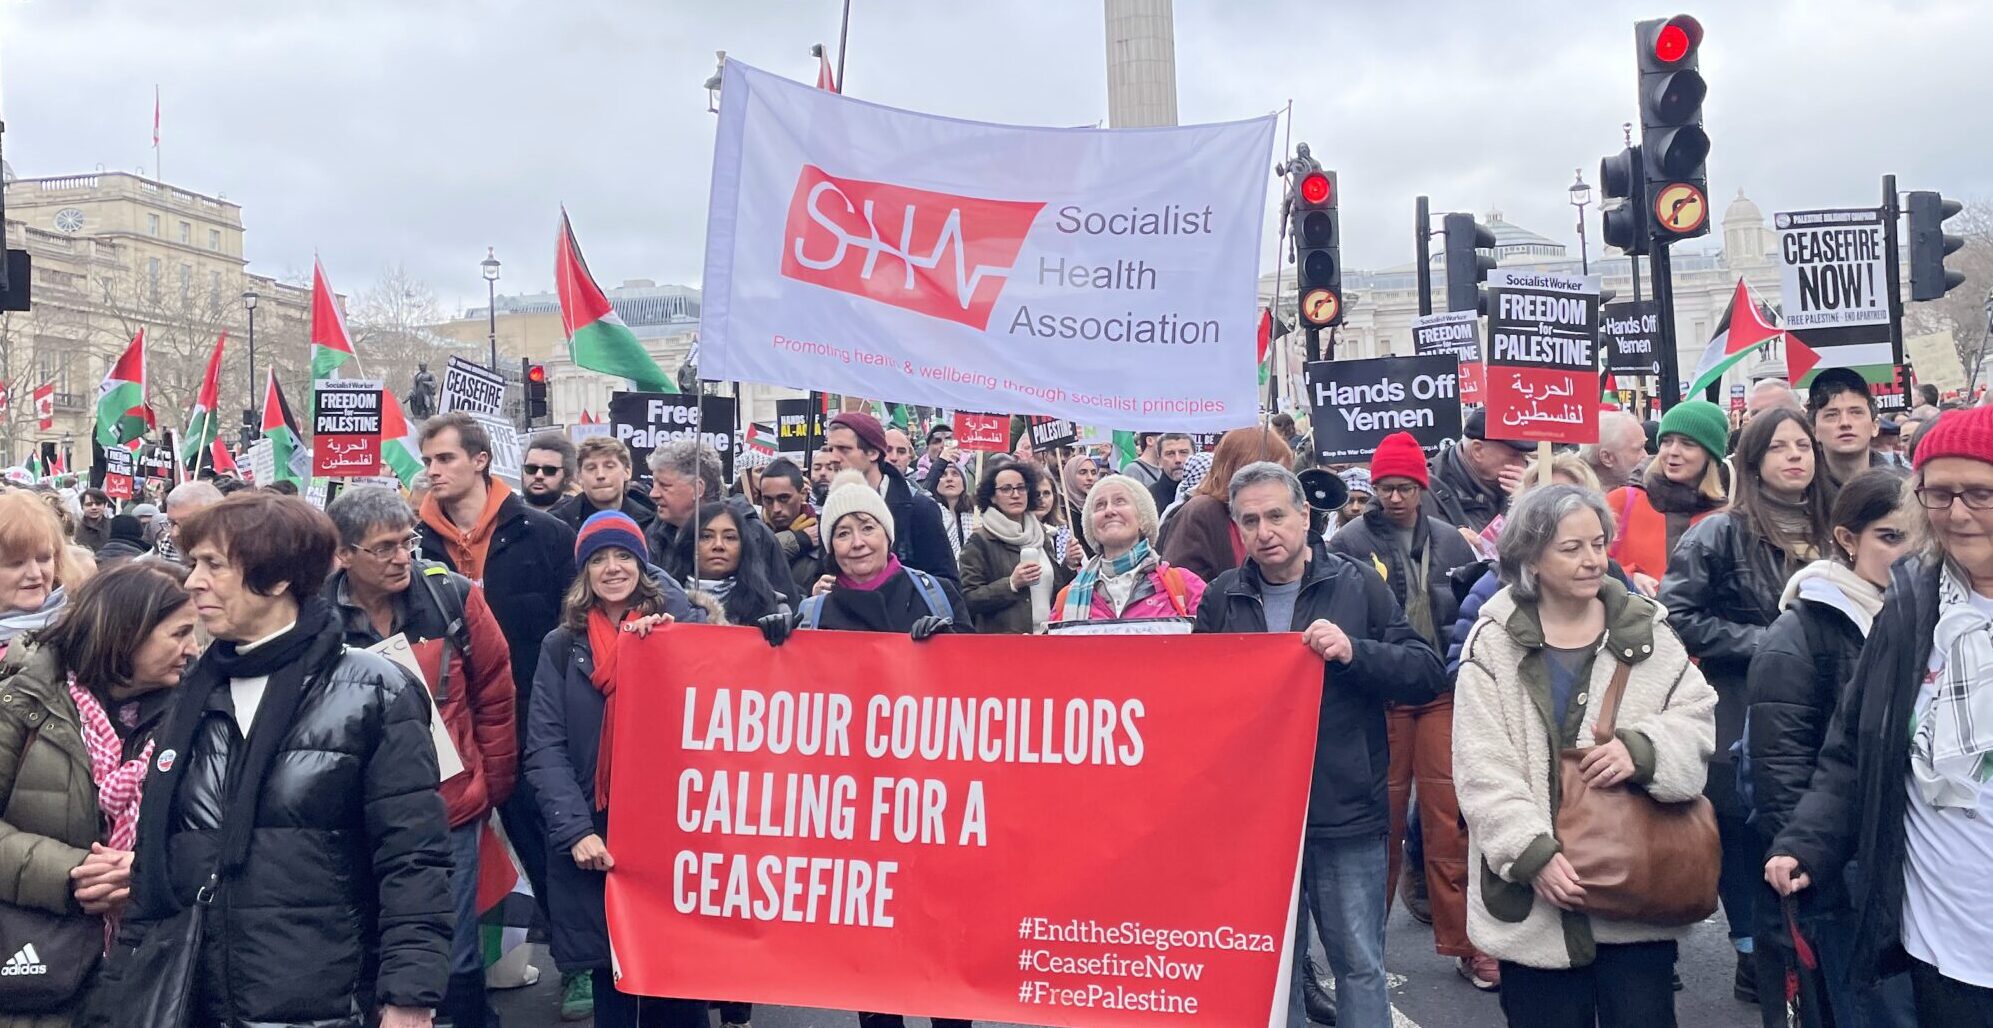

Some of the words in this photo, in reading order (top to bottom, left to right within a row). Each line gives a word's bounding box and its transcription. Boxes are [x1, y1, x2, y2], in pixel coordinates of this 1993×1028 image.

[1055, 204, 1213, 235] Socialist
[1783, 228, 1881, 265] CEASEFIRE
[1038, 256, 1158, 291] Health
[1798, 262, 1876, 311] NOW!
[1500, 293, 1587, 326] FREEDOM
[1787, 314, 1805, 325] FREE
[1806, 312, 1840, 325] PALESTINE
[1845, 311, 1856, 321] END
[1857, 309, 1887, 321] APARTHEID
[1009, 305, 1220, 345] Association
[1418, 323, 1473, 344] FREEDOM
[1538, 321, 1553, 335] for
[1606, 317, 1641, 335] Hands
[1641, 314, 1656, 333] Off
[1494, 333, 1592, 366] PALESTINE
[1615, 336, 1652, 354] Yemen
[773, 335, 850, 363] Promoting
[903, 360, 914, 375] &
[919, 364, 998, 390] wellbeing
[1003, 379, 1066, 402] through
[1071, 390, 1137, 411] socialist
[1143, 397, 1225, 415] principles
[1511, 373, 1574, 400] الحرية
[320, 393, 377, 409] FREEDOM
[446, 369, 503, 408] CEASEFIRE
[1315, 377, 1406, 407] Hands
[1411, 373, 1456, 400] Off
[317, 416, 379, 432] PALESTINE
[343, 408, 355, 416] for
[647, 399, 703, 425] Free
[965, 417, 998, 432] الحرية
[1338, 407, 1434, 432] Yemen
[1503, 400, 1584, 426] لفلسطين
[960, 431, 1003, 444] لفلسطين
[1033, 420, 1073, 445] PALESTINE
[327, 438, 368, 454] الحرية
[321, 453, 373, 469] لفلسطين
[681, 686, 853, 757] LABOUR
[865, 695, 1146, 767] COUNCILLORS
[677, 768, 857, 841] CALLING
[869, 776, 947, 846] FOR
[959, 781, 987, 847] A
[673, 850, 899, 928] CEASEFIRE
[1018, 917, 1275, 953] #EndtheSiegeonGaza
[1, 963, 47, 976] adidas
[1018, 950, 1204, 981] #CeasefireNow
[1018, 981, 1198, 1015] #FreePalestine
